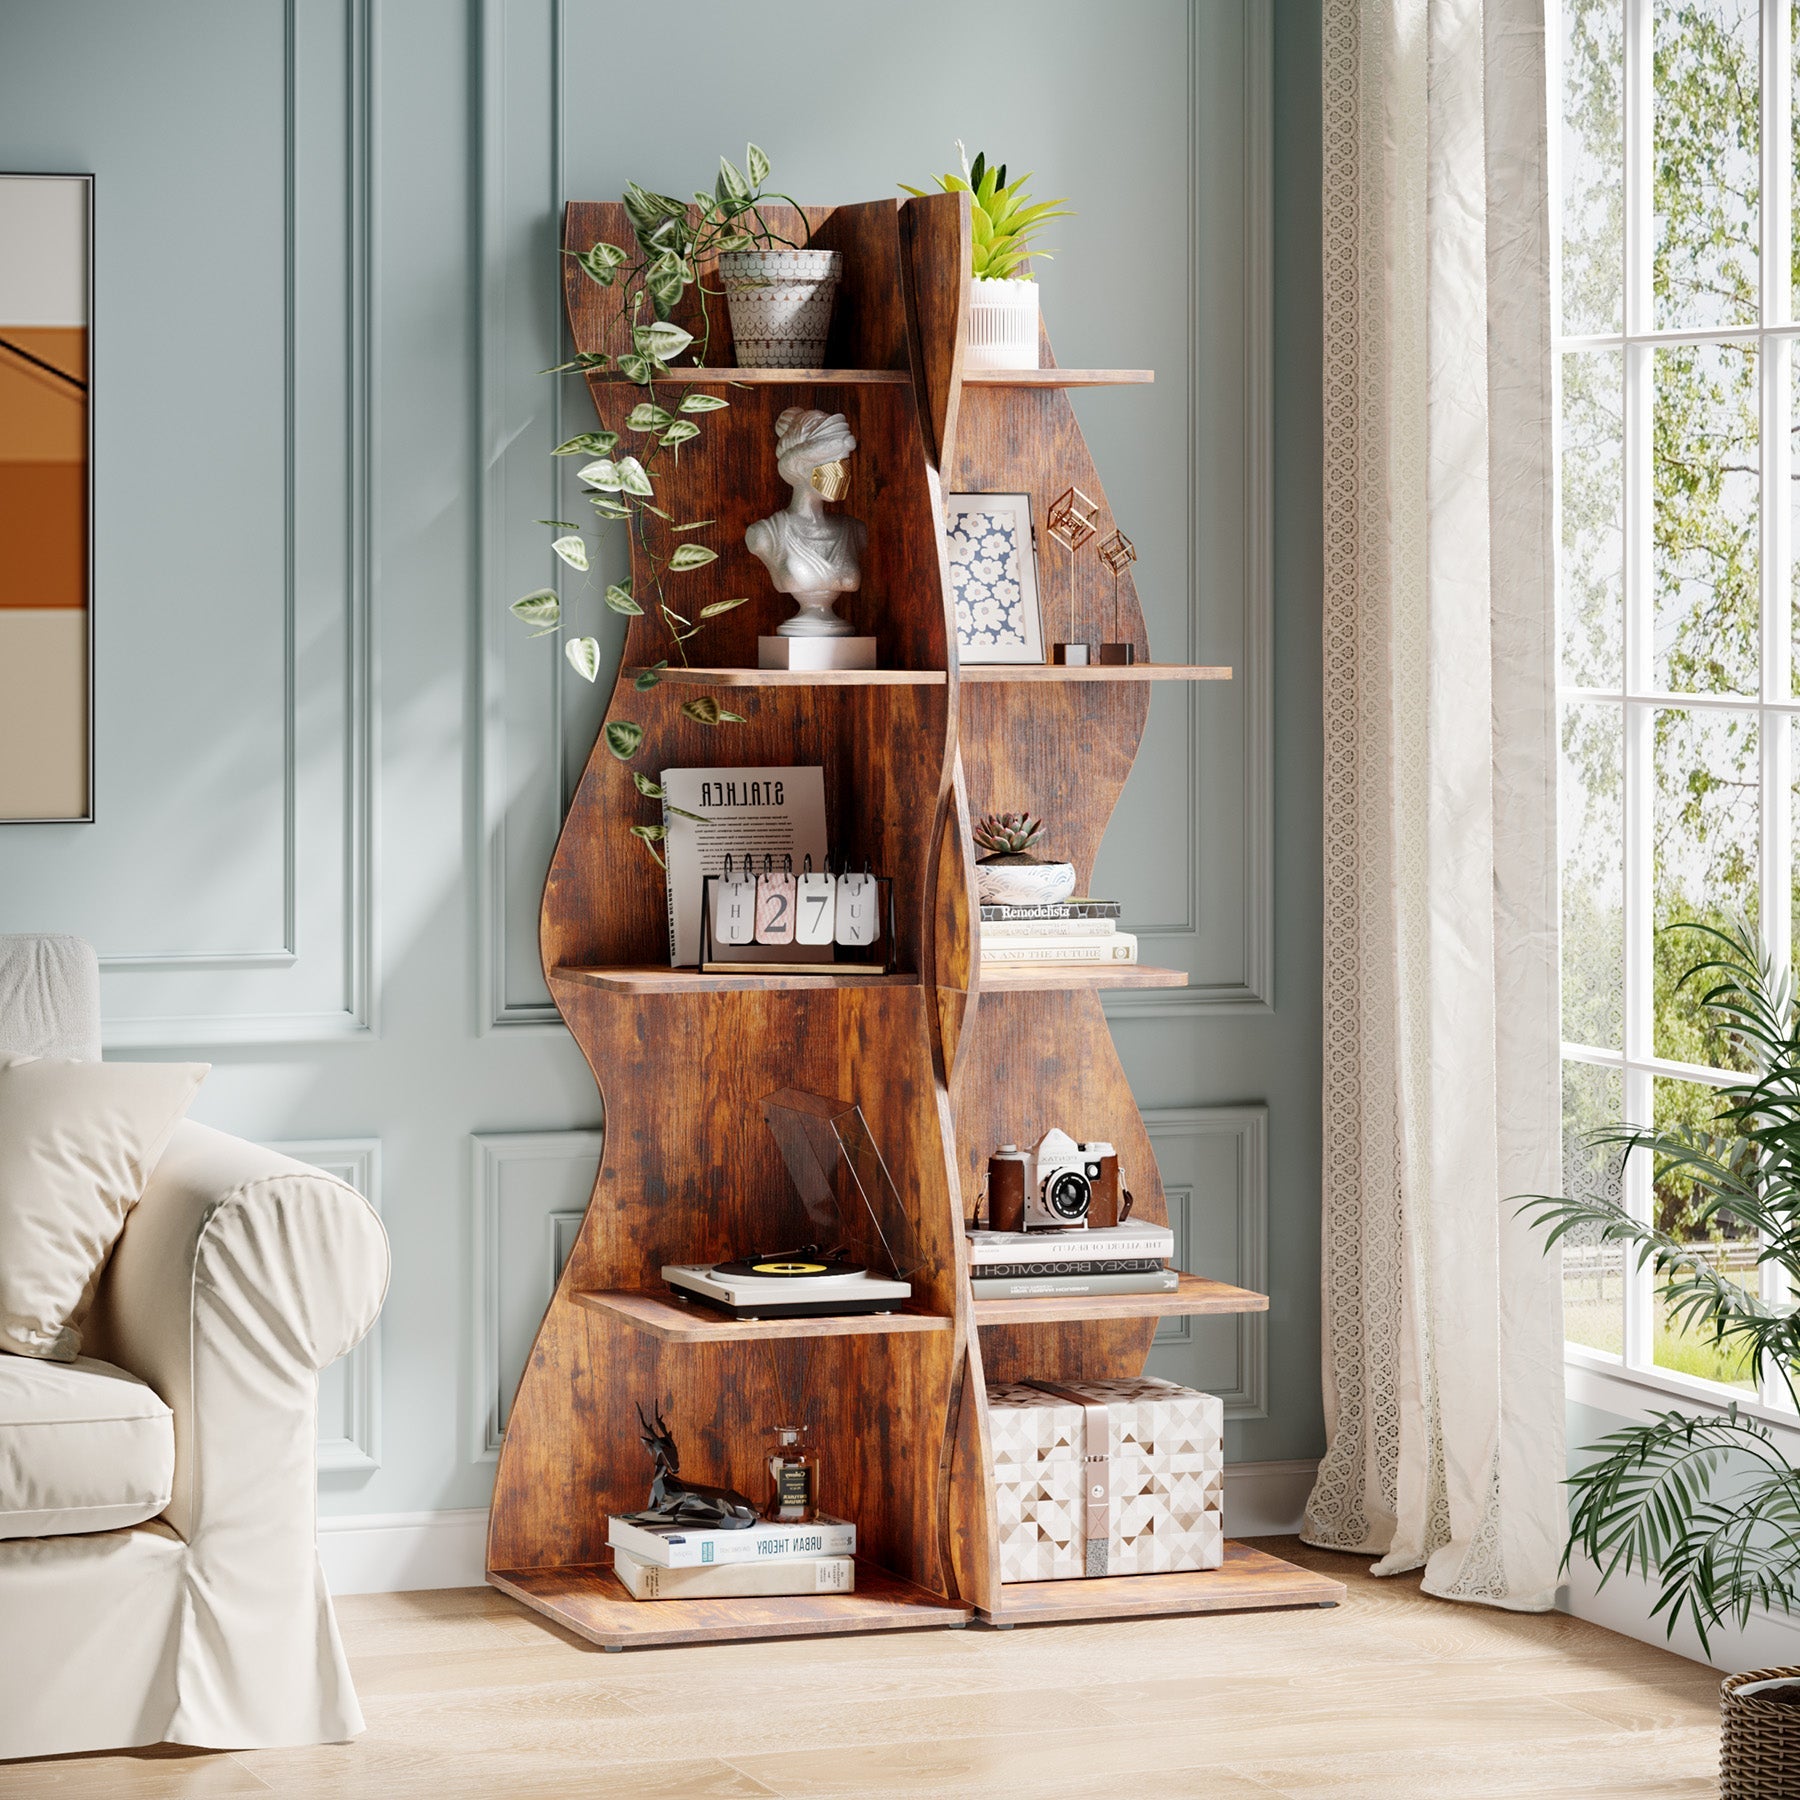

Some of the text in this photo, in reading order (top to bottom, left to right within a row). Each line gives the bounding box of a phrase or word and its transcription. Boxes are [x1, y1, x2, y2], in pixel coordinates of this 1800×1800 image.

[1002, 904, 1070, 919] Remodelista
[1002, 950, 1025, 959] AND
[1029, 950, 1052, 959] THE
[1056, 949, 1101, 958] FUTURE
